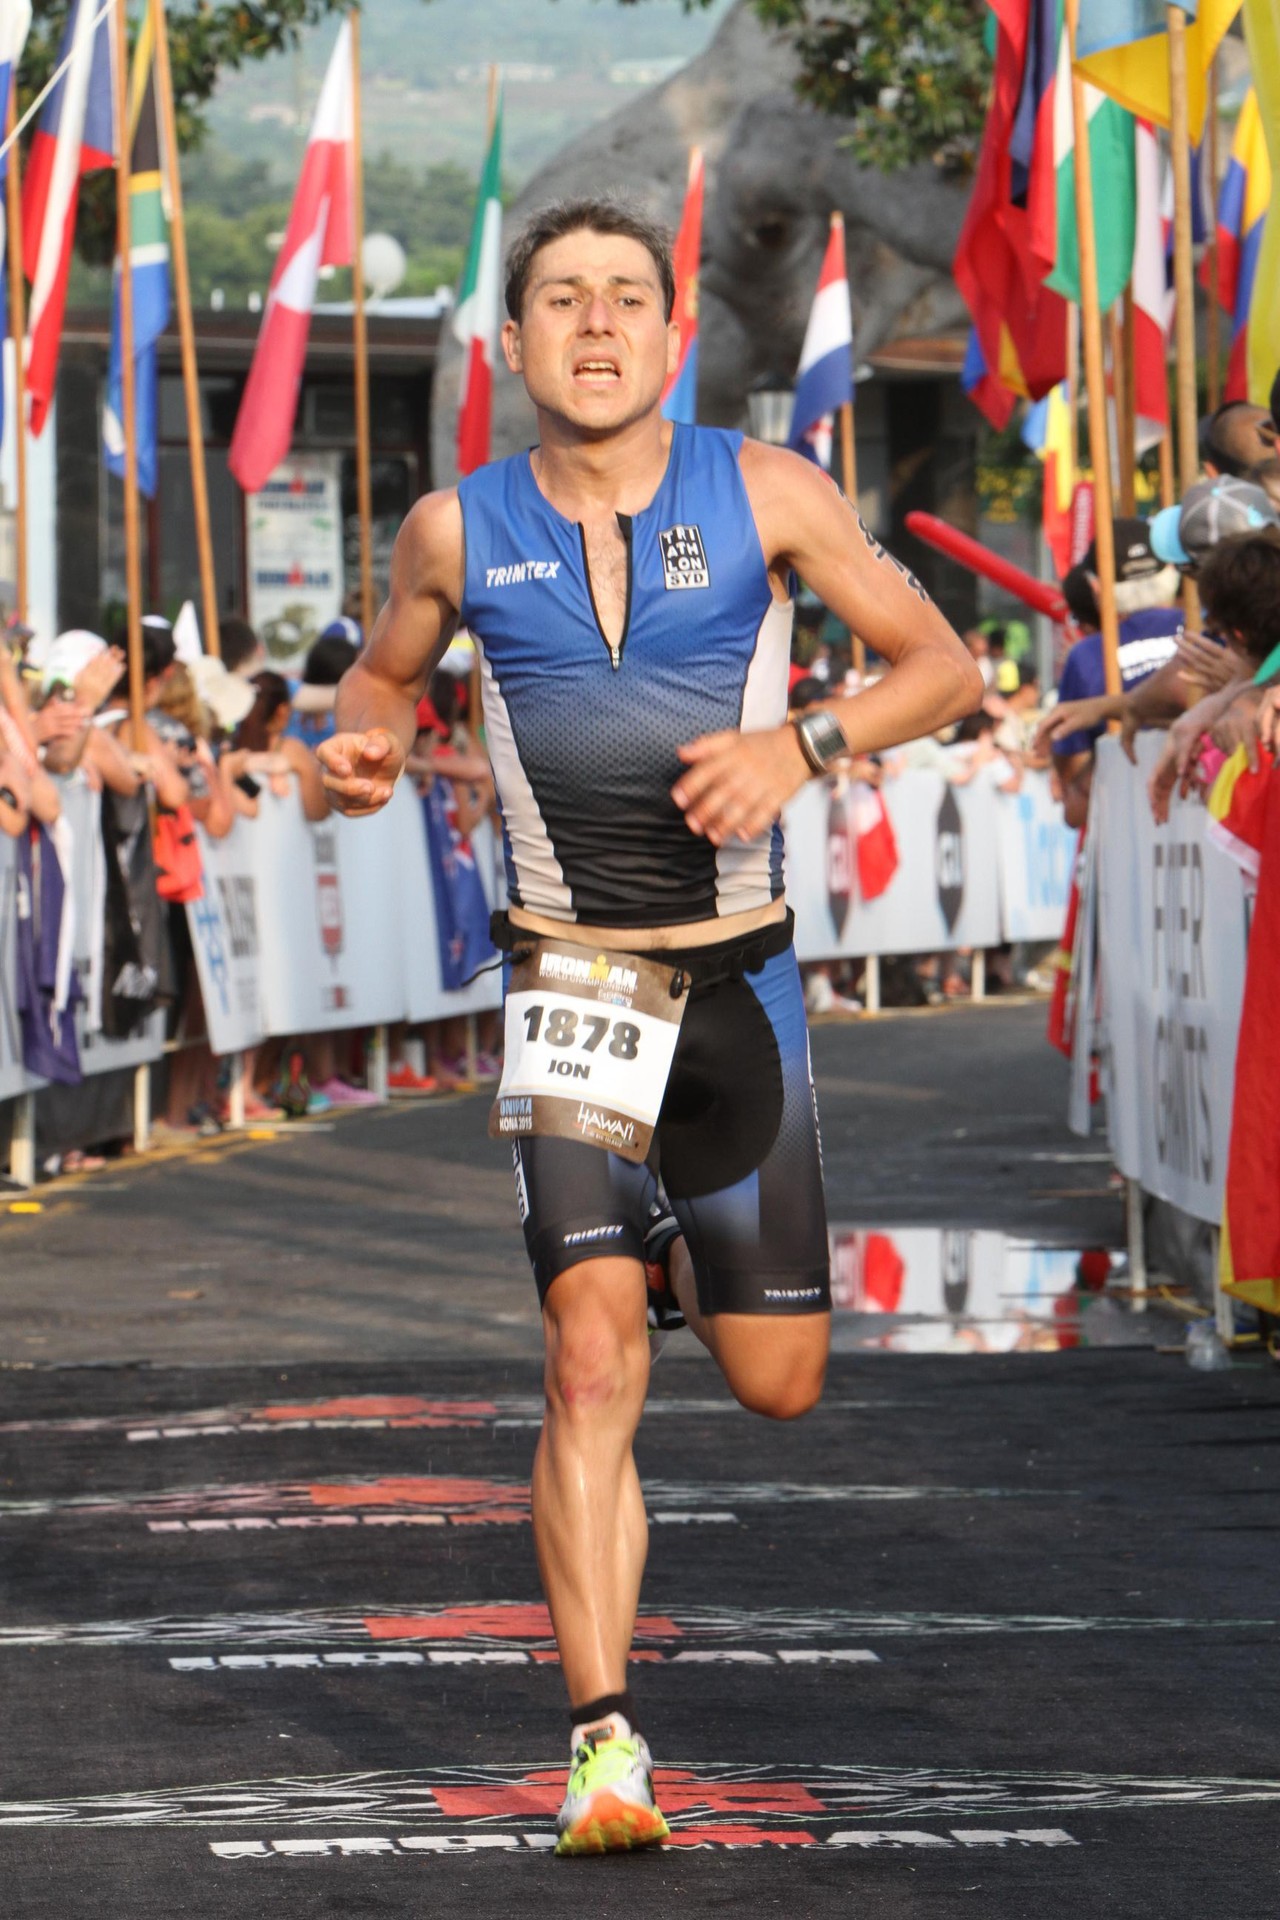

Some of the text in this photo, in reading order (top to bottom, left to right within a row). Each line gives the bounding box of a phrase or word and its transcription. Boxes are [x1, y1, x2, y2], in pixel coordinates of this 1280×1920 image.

[663, 526, 695, 544] TRI
[667, 542, 699, 558] ATH
[668, 557, 702, 572] LON
[486, 560, 560, 588] TRIMTEX
[670, 572, 704, 585] SYD
[539, 953, 638, 988] IRONMAN
[539, 970, 636, 994] WORLD CHAMPIONSHIP
[524, 1005, 641, 1059] 1878
[548, 1059, 591, 1079] JON
[500, 1116, 533, 1132] KONA 2015
[216, 1841, 1081, 1859] WORLD CMPIONSHIP
